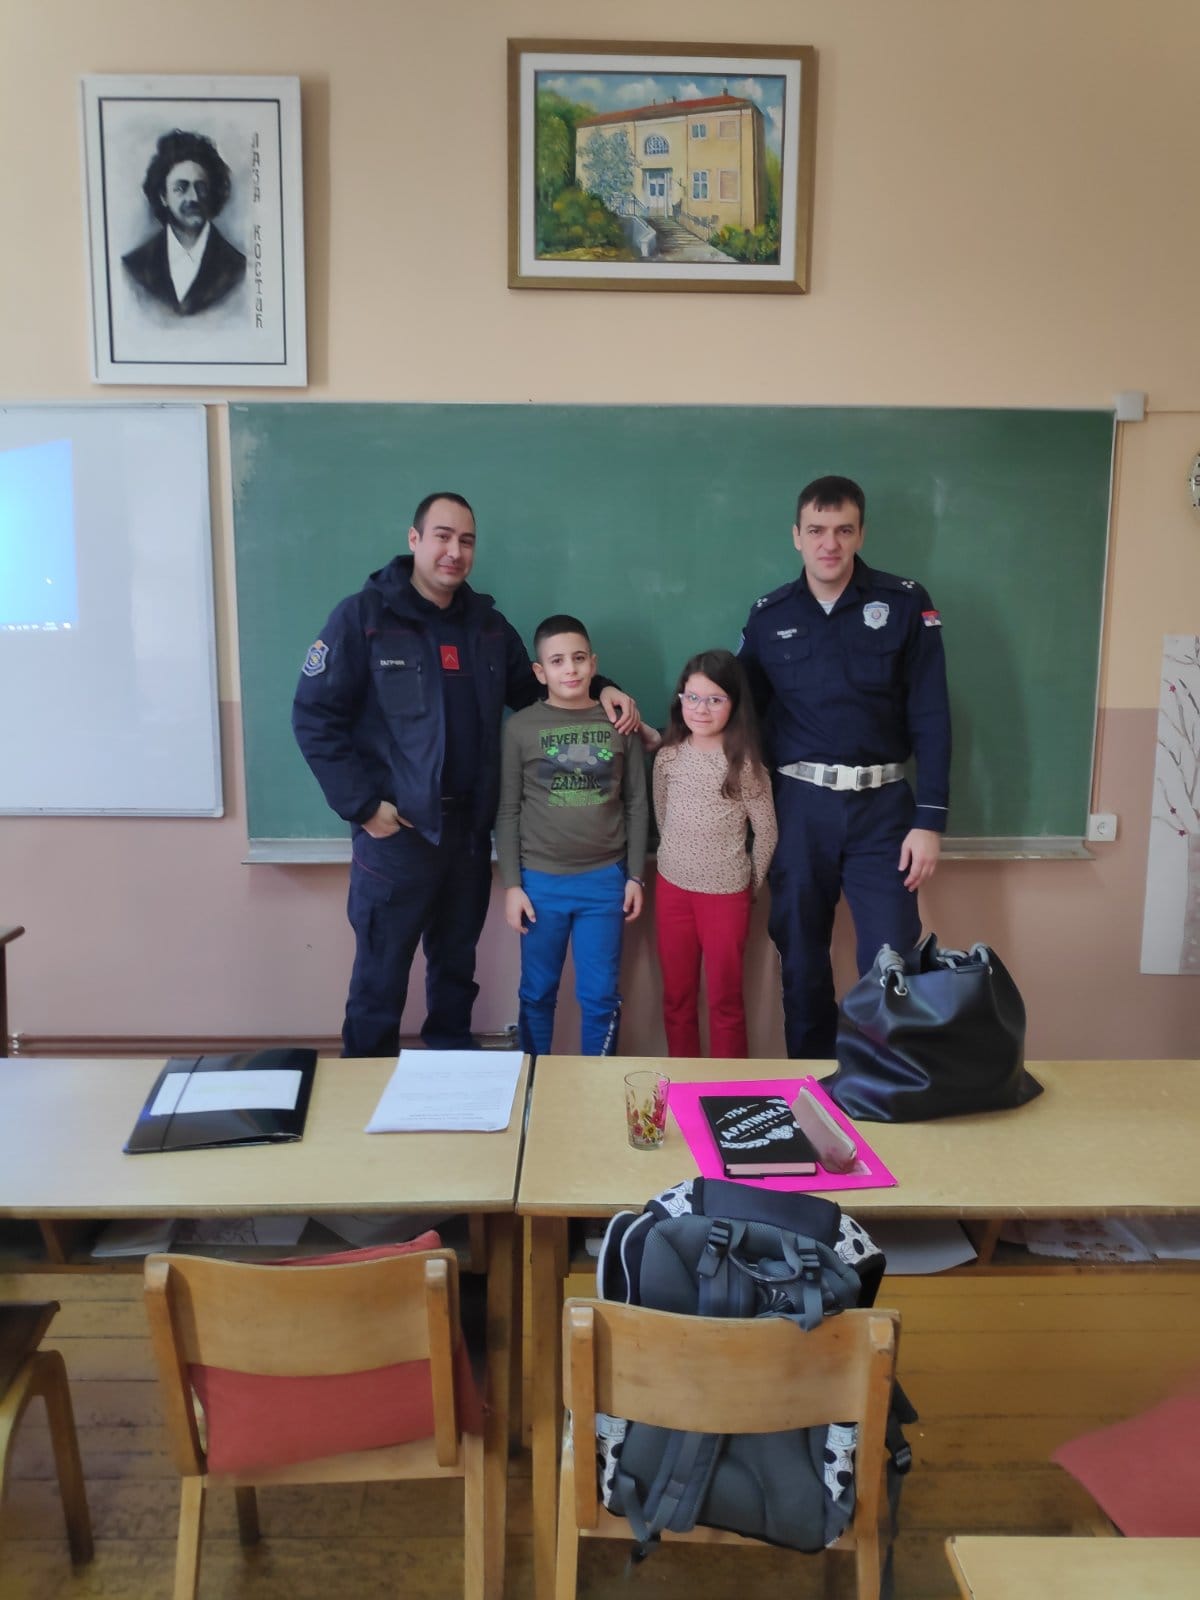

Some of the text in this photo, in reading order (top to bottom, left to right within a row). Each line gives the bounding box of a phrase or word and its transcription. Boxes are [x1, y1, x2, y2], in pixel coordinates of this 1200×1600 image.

[541, 730, 611, 749] NEVER STOP
[724, 1106, 748, 1119] 1756
[720, 1105, 790, 1140] APATINSKA
